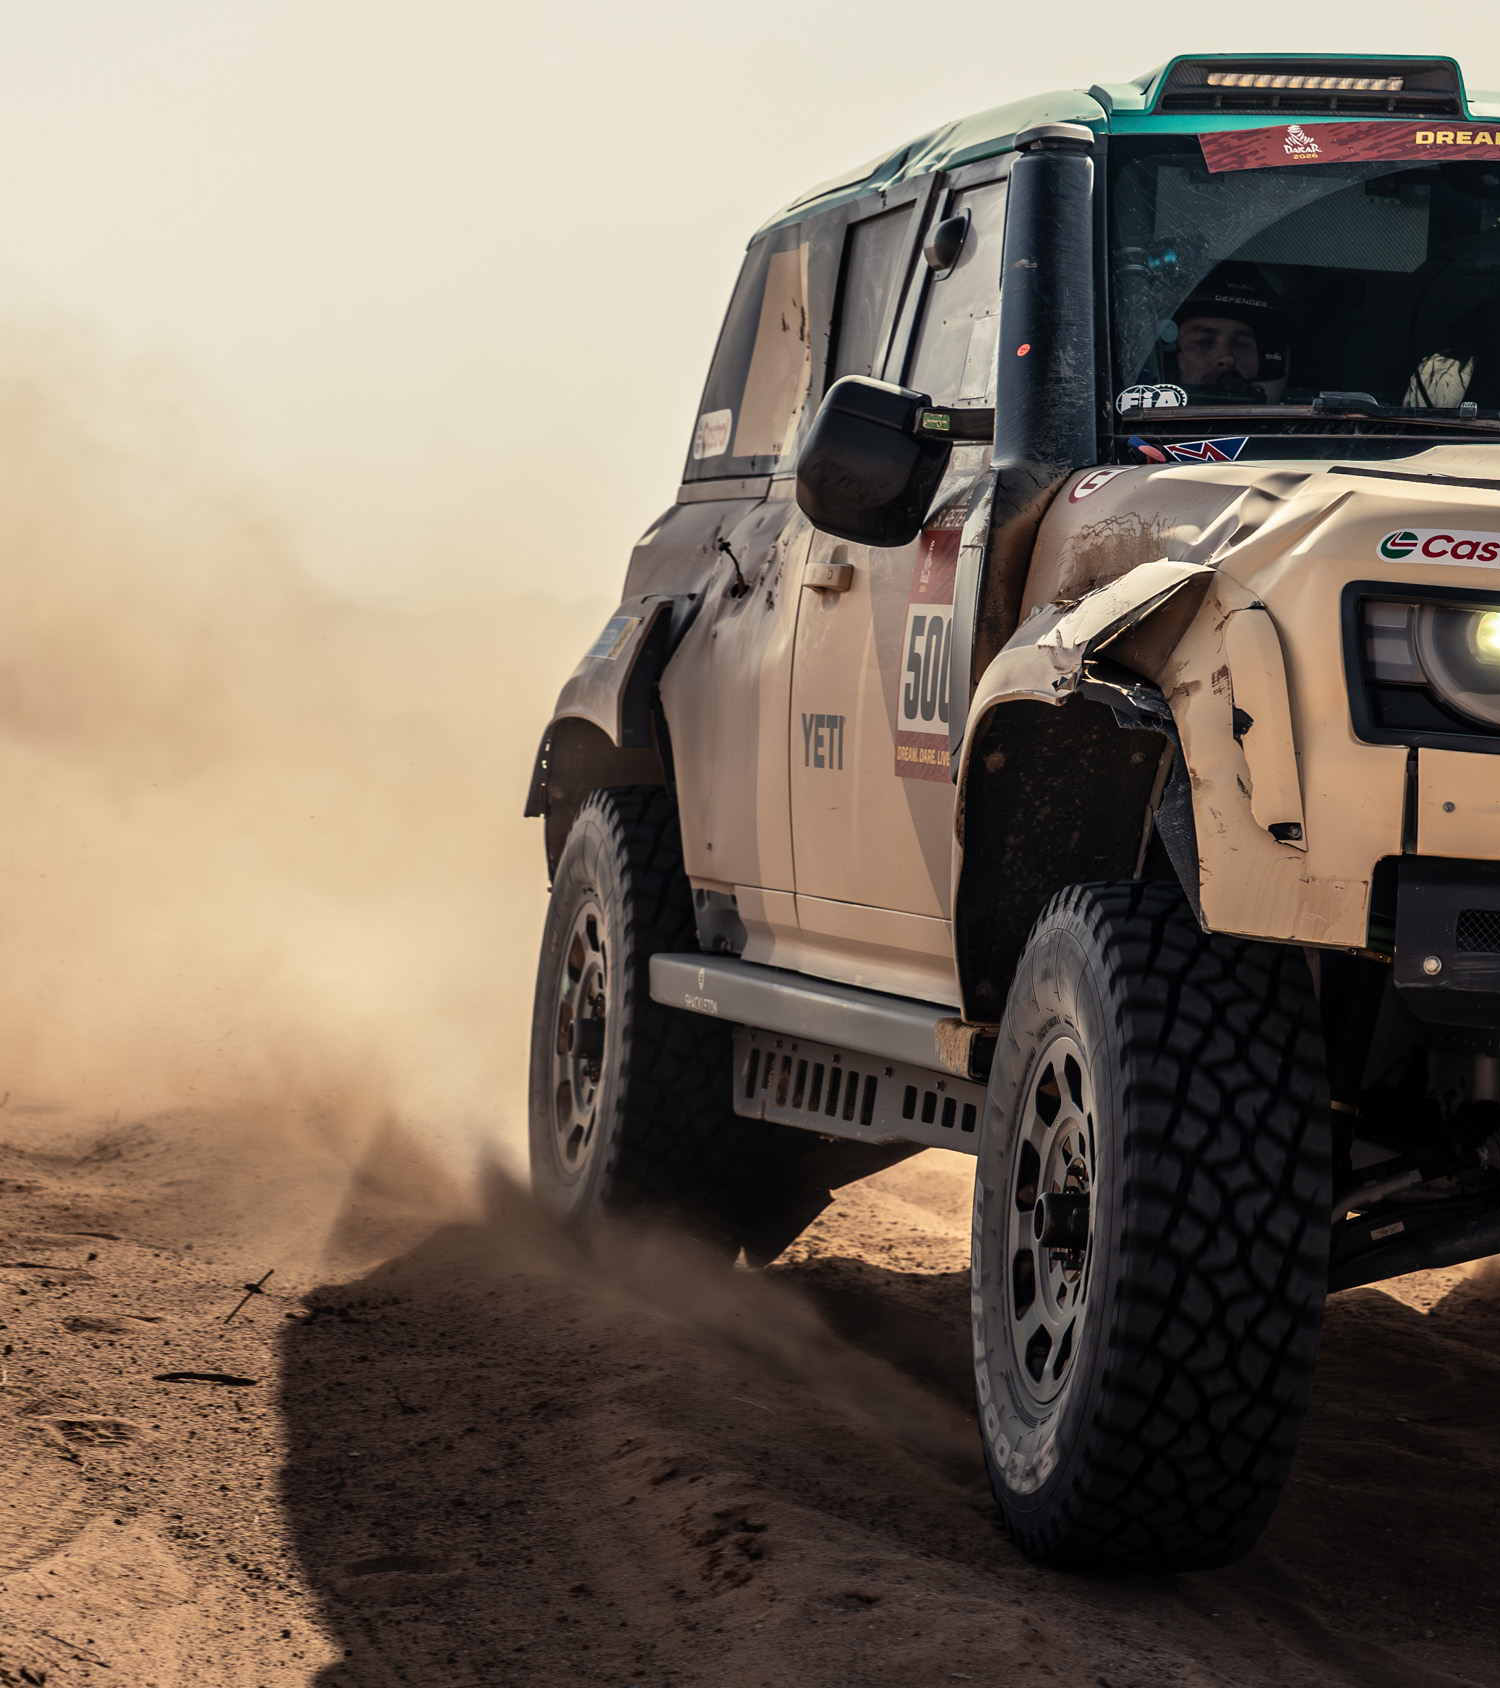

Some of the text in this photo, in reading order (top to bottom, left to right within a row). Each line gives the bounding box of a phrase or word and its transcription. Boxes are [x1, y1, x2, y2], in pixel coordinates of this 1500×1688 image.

[1283, 143, 1323, 154] DAKAR
[1214, 295, 1268, 308] DEFENDER
[801, 713, 845, 771] YETI
